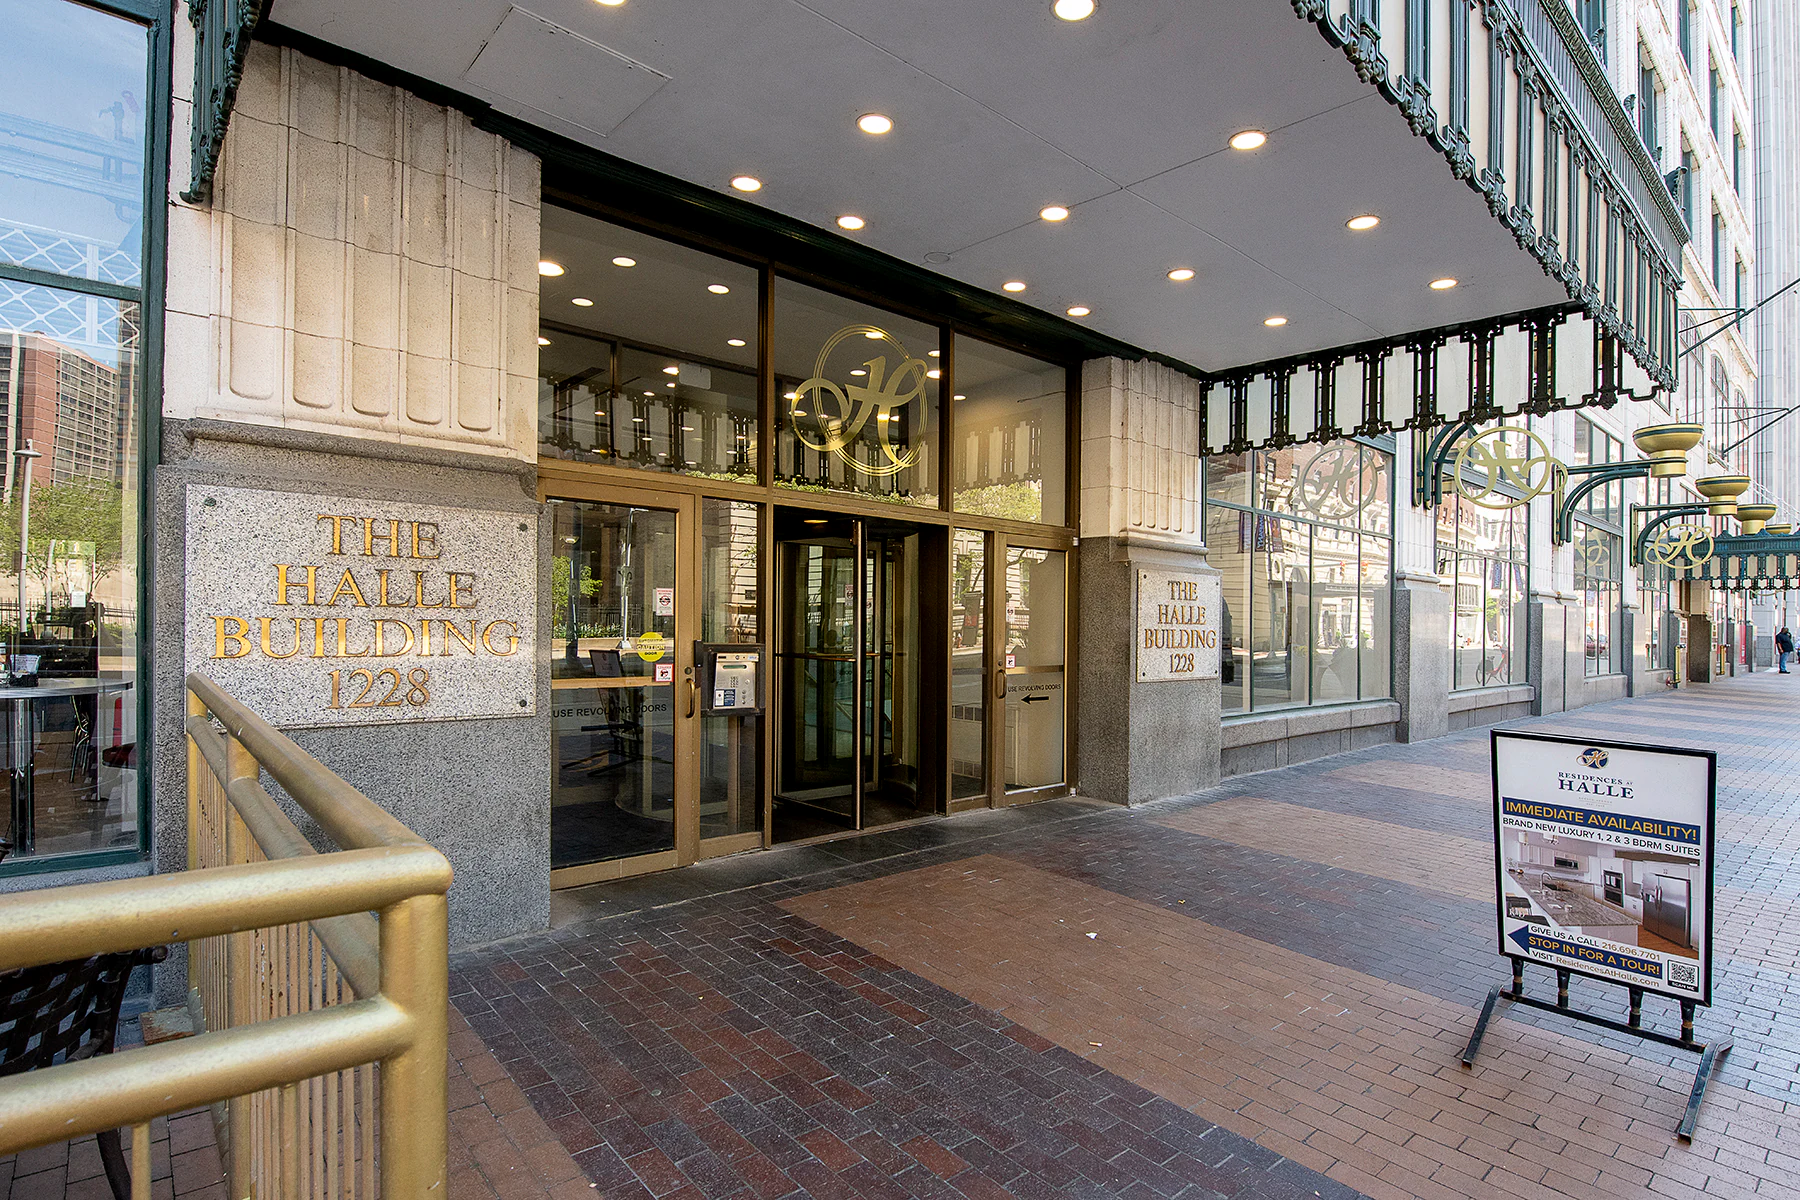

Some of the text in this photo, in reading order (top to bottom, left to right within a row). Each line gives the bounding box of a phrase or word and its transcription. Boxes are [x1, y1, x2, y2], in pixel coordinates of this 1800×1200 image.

[317, 514, 441, 559] THE
[271, 563, 479, 609] HALLE
[1167, 580, 1198, 601] THE
[1158, 604, 1206, 625] HALLE
[209, 615, 521, 660] BUILDING
[1144, 629, 1217, 649] BUILDING
[1169, 652, 1195, 673] 1228
[326, 666, 432, 710] 1228
[1007, 685, 1017, 693] USE
[1018, 684, 1044, 692] REVOLVING
[553, 709, 573, 718] USE
[634, 703, 667, 714] DOORS
[1558, 771, 1623, 785] RESIDENCES
[1558, 778, 1634, 799] HALLE
[1505, 801, 1697, 841] IMMEDIATE AVAILABILITY!
[1503, 817, 1533, 829] BRAND
[1535, 822, 1556, 833] NEW
[1558, 826, 1595, 840] LUXURY
[1606, 834, 1612, 842] 2
[1614, 835, 1621, 843] &
[1623, 836, 1630, 845] 3
[1632, 838, 1662, 851] BDRM
[1664, 843, 1700, 857] SUITES
[1528, 936, 1660, 975] STOP IN FOR A TOUR!
[1530, 925, 1551, 936] GIVE
[1553, 930, 1566, 939] US
[1576, 936, 1600, 948] CALL
[1601, 941, 1660, 961] 216.696.7701
[1531, 950, 1660, 988] VISIT ResidencesAtHalle.com
[1671, 981, 1686, 989] SCAN
